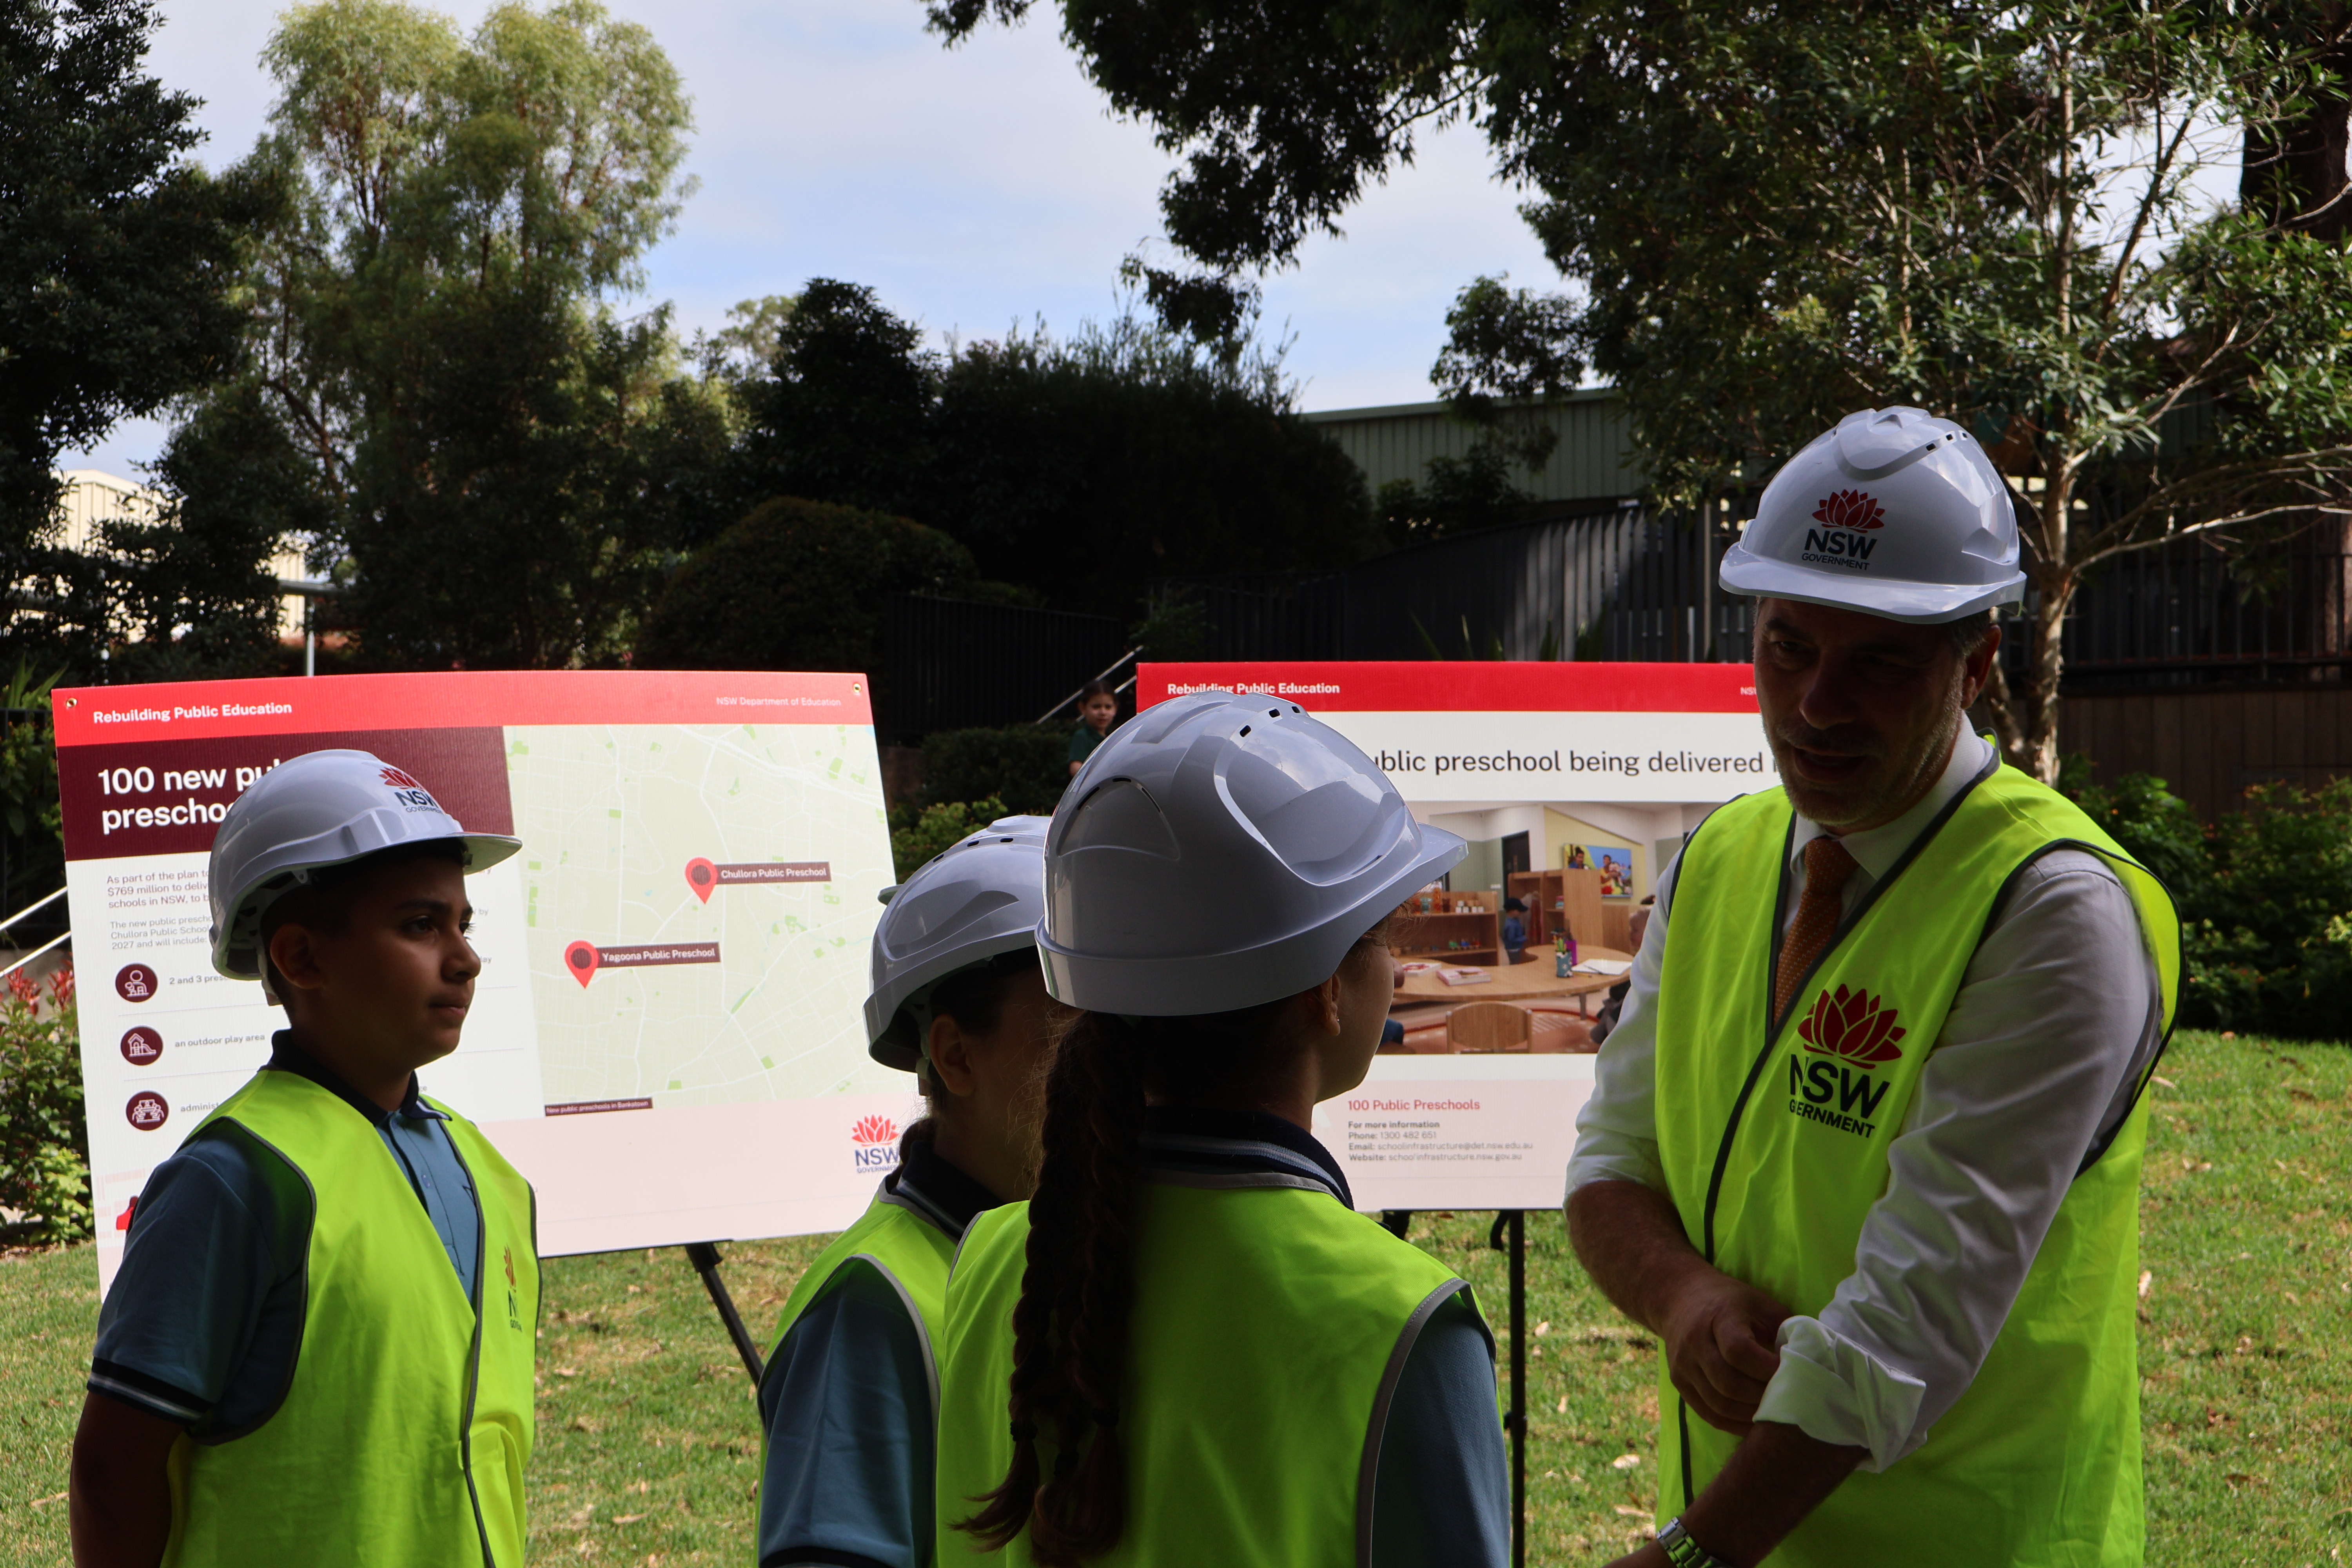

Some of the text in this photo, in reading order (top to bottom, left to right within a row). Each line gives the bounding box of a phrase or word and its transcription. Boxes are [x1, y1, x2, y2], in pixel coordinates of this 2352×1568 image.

[1804, 529, 1877, 560] NSW
[1802, 553, 1870, 570] GOVERNMENT
[1237, 682, 1275, 694] Public
[1278, 682, 1340, 693] Education
[716, 697, 841, 706] NSW Department of Education
[94, 702, 292, 724] Rebuilding Public Education
[1435, 750, 1561, 775] preschool
[1570, 750, 1640, 776] being
[1648, 750, 1763, 773] delivered
[98, 766, 155, 795] 100
[164, 768, 227, 791] new
[394, 791, 439, 808] NSW
[107, 875, 120, 884] As
[122, 874, 142, 884] part
[145, 872, 156, 881] of
[158, 871, 175, 880] the
[177, 870, 199, 880] plan
[721, 867, 827, 879] Chullora Public Preschool
[107, 881, 207, 897] $769 million to deliv
[109, 898, 147, 908] schools
[149, 897, 158, 906] in
[161, 894, 188, 905] NSW,
[191, 894, 200, 902] to
[110, 921, 126, 929] The
[149, 917, 176, 927] public
[178, 915, 212, 925] prescho
[111, 930, 148, 939] Chullora
[150, 928, 178, 936] Public
[112, 936, 207, 950] 2027 and will include:
[602, 948, 716, 963] Yagoona Public Preschool
[169, 976, 175, 985] 2
[178, 975, 194, 984] and
[188, 1037, 223, 1047] outdoor
[225, 1035, 243, 1044] play
[1789, 1054, 1890, 1119] NSW
[561, 1105, 578, 1114] public
[579, 1102, 610, 1112] preschools
[618, 1100, 649, 1109] Bankstown
[1348, 1098, 1481, 1111] 100 Public Preschools
[1389, 1120, 1440, 1129] information
[1789, 1099, 1875, 1138] GERNMENT
[1348, 1131, 1437, 1140] Phone: 1300 482 651
[1349, 1142, 1376, 1151] Email:
[855, 1146, 900, 1166] NSW
[1349, 1153, 1386, 1161] Website:
